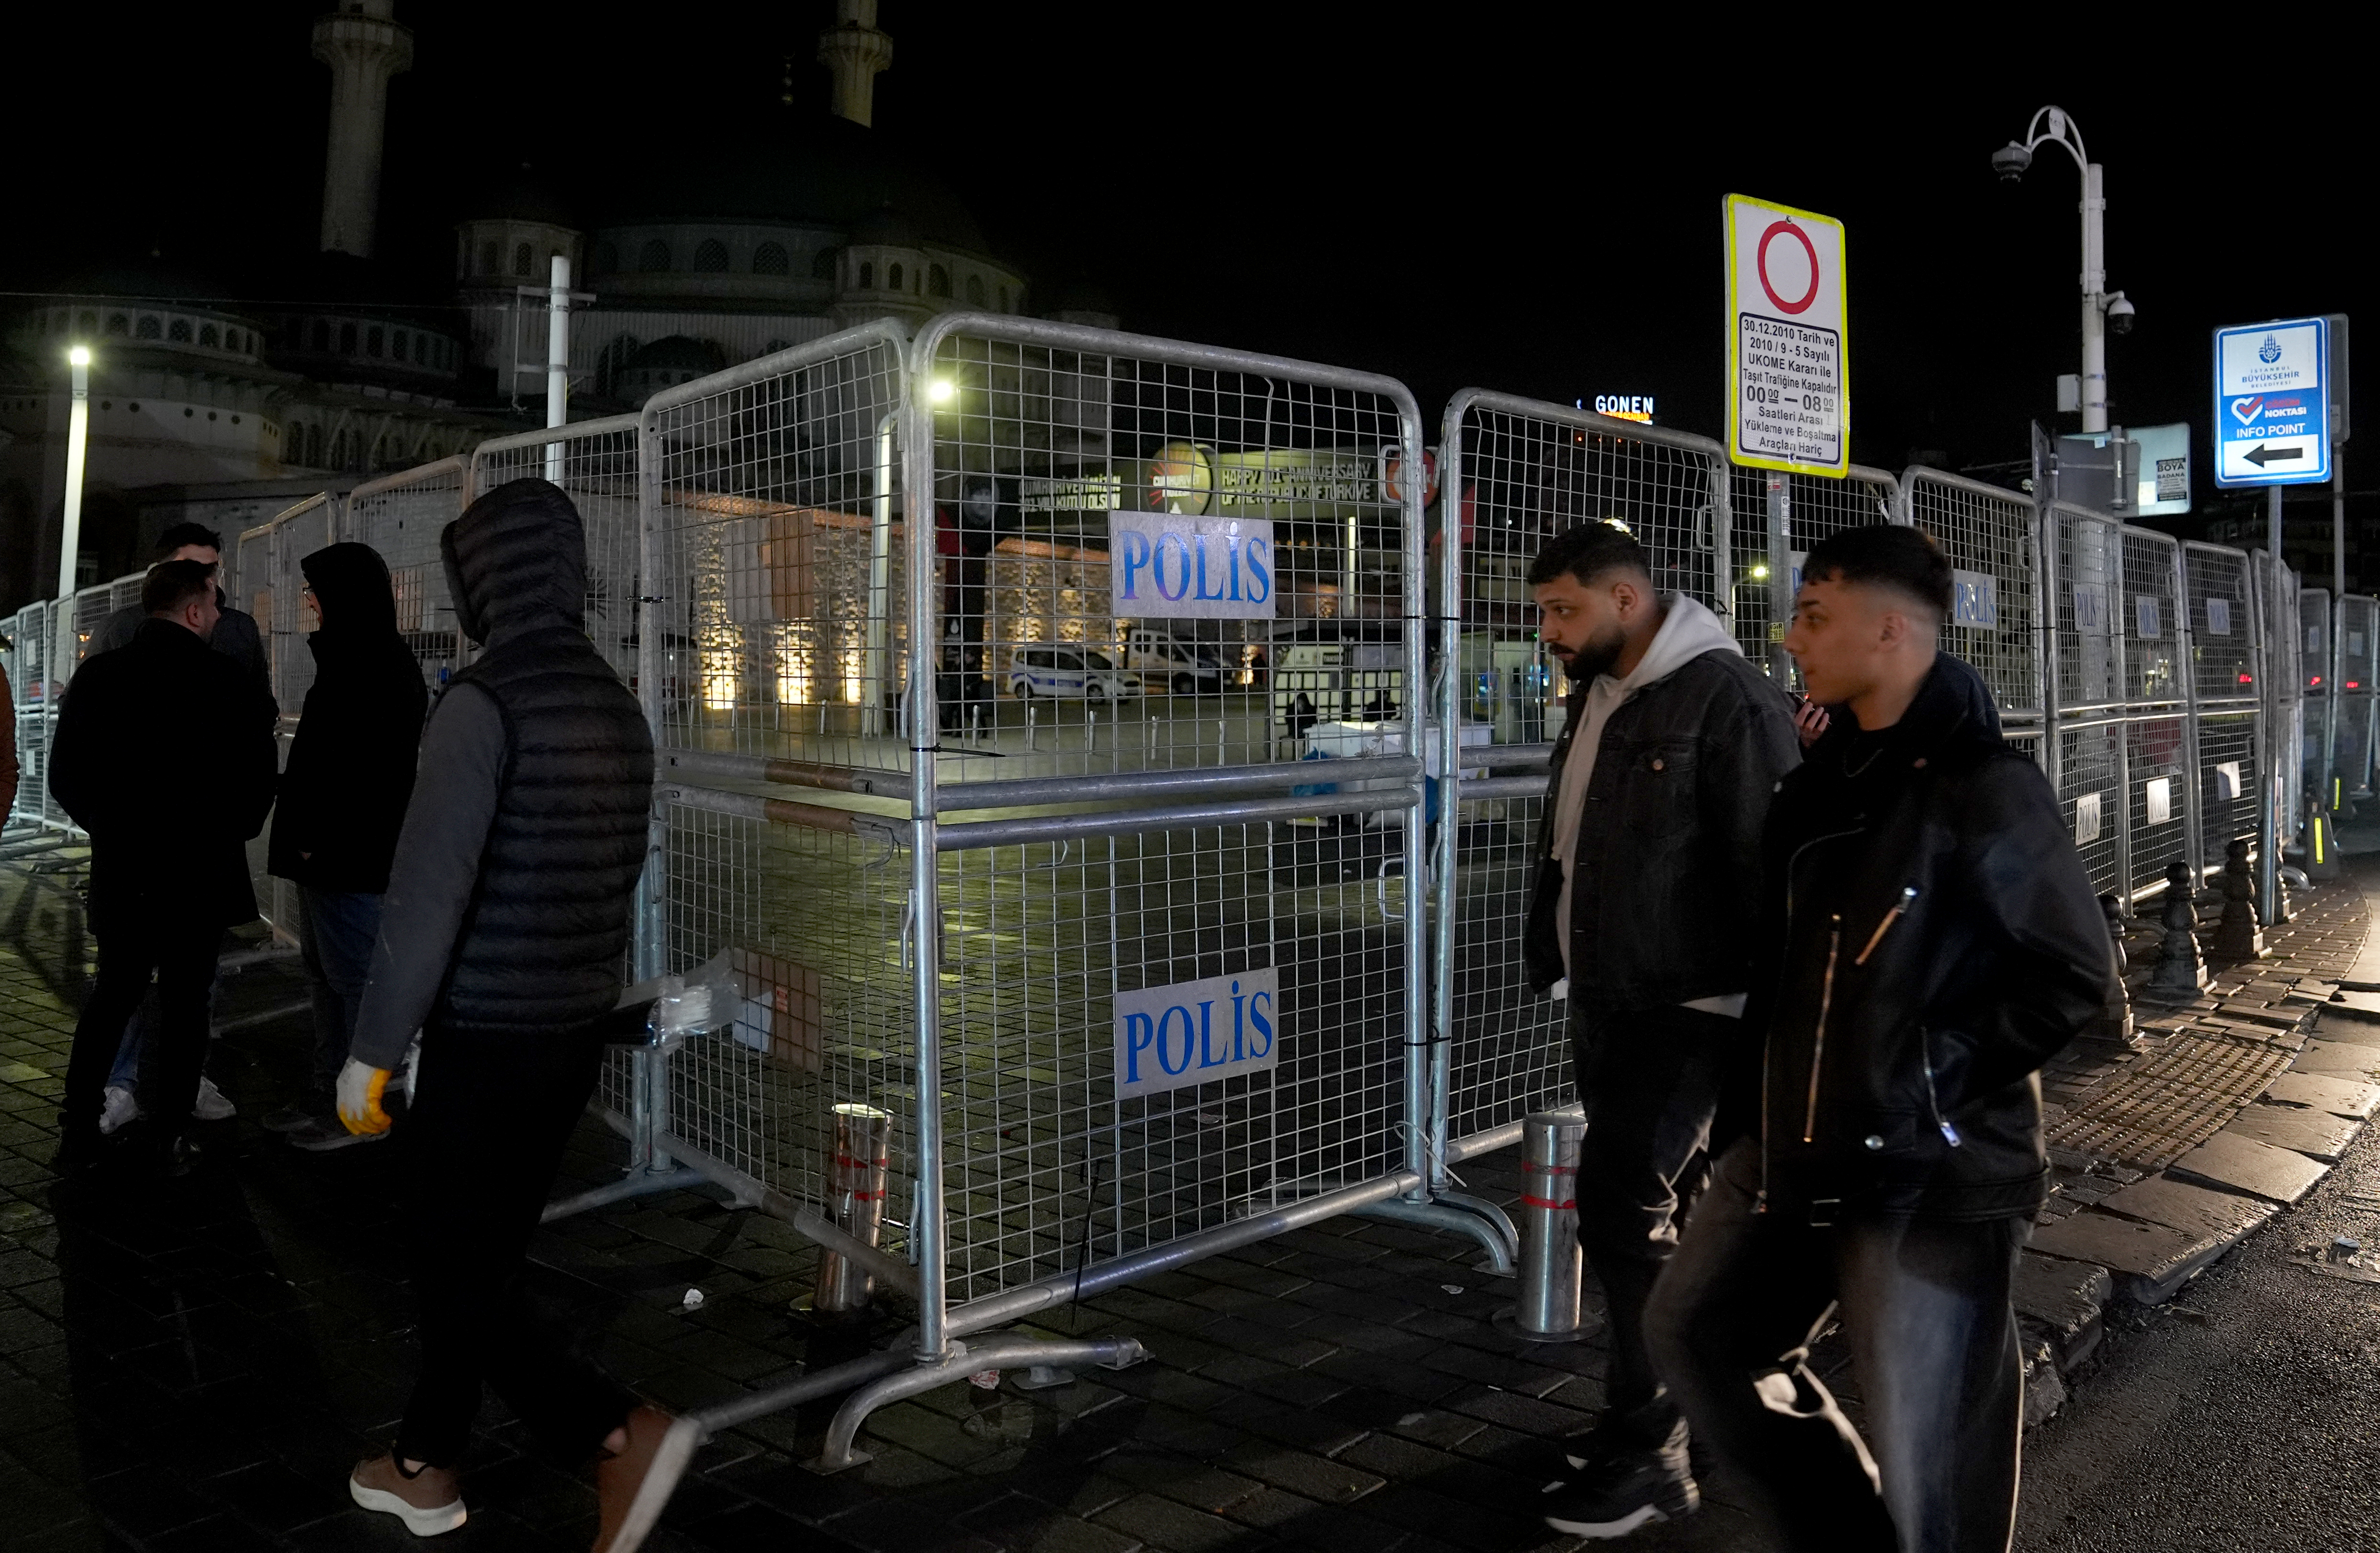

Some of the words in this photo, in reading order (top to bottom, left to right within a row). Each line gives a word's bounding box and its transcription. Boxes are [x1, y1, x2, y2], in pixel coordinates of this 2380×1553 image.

[1744, 319, 1794, 339] 30.12.2010
[1797, 330, 1820, 344] Tarih
[1824, 337, 1834, 346] ve
[1750, 337, 1772, 351] 2010
[1775, 342, 1778, 352] /
[1781, 343, 1786, 353] 9
[1796, 345, 1800, 356] 5
[1804, 347, 1829, 362] Sayılı
[1749, 353, 1785, 370] UKOME
[1789, 360, 1817, 375] Kararı
[1820, 366, 1831, 377] ile
[2242, 370, 2299, 383] BÜYÜKŞEHİR
[1743, 368, 1762, 384] Taşıt
[1765, 372, 1799, 388] Trafiğine
[1802, 378, 1836, 394] Kapalıdır
[1759, 406, 1796, 421] Saatleri
[1798, 412, 1823, 425] Arası
[2265, 407, 2307, 418] NOKTASI
[1745, 419, 1782, 434] Yükleme
[1785, 427, 1794, 436] ve
[1797, 427, 1836, 442] Boşaltma
[2237, 426, 2265, 438] INFO
[2268, 422, 2305, 436] POINT
[1759, 436, 1796, 452] Araçları
[1799, 442, 1822, 457] Hariç
[2158, 463, 2184, 472] BOYA
[1118, 521, 1269, 604] POLİS
[2078, 796, 2098, 840] POLİS
[1123, 980, 1272, 1084] POLİS
